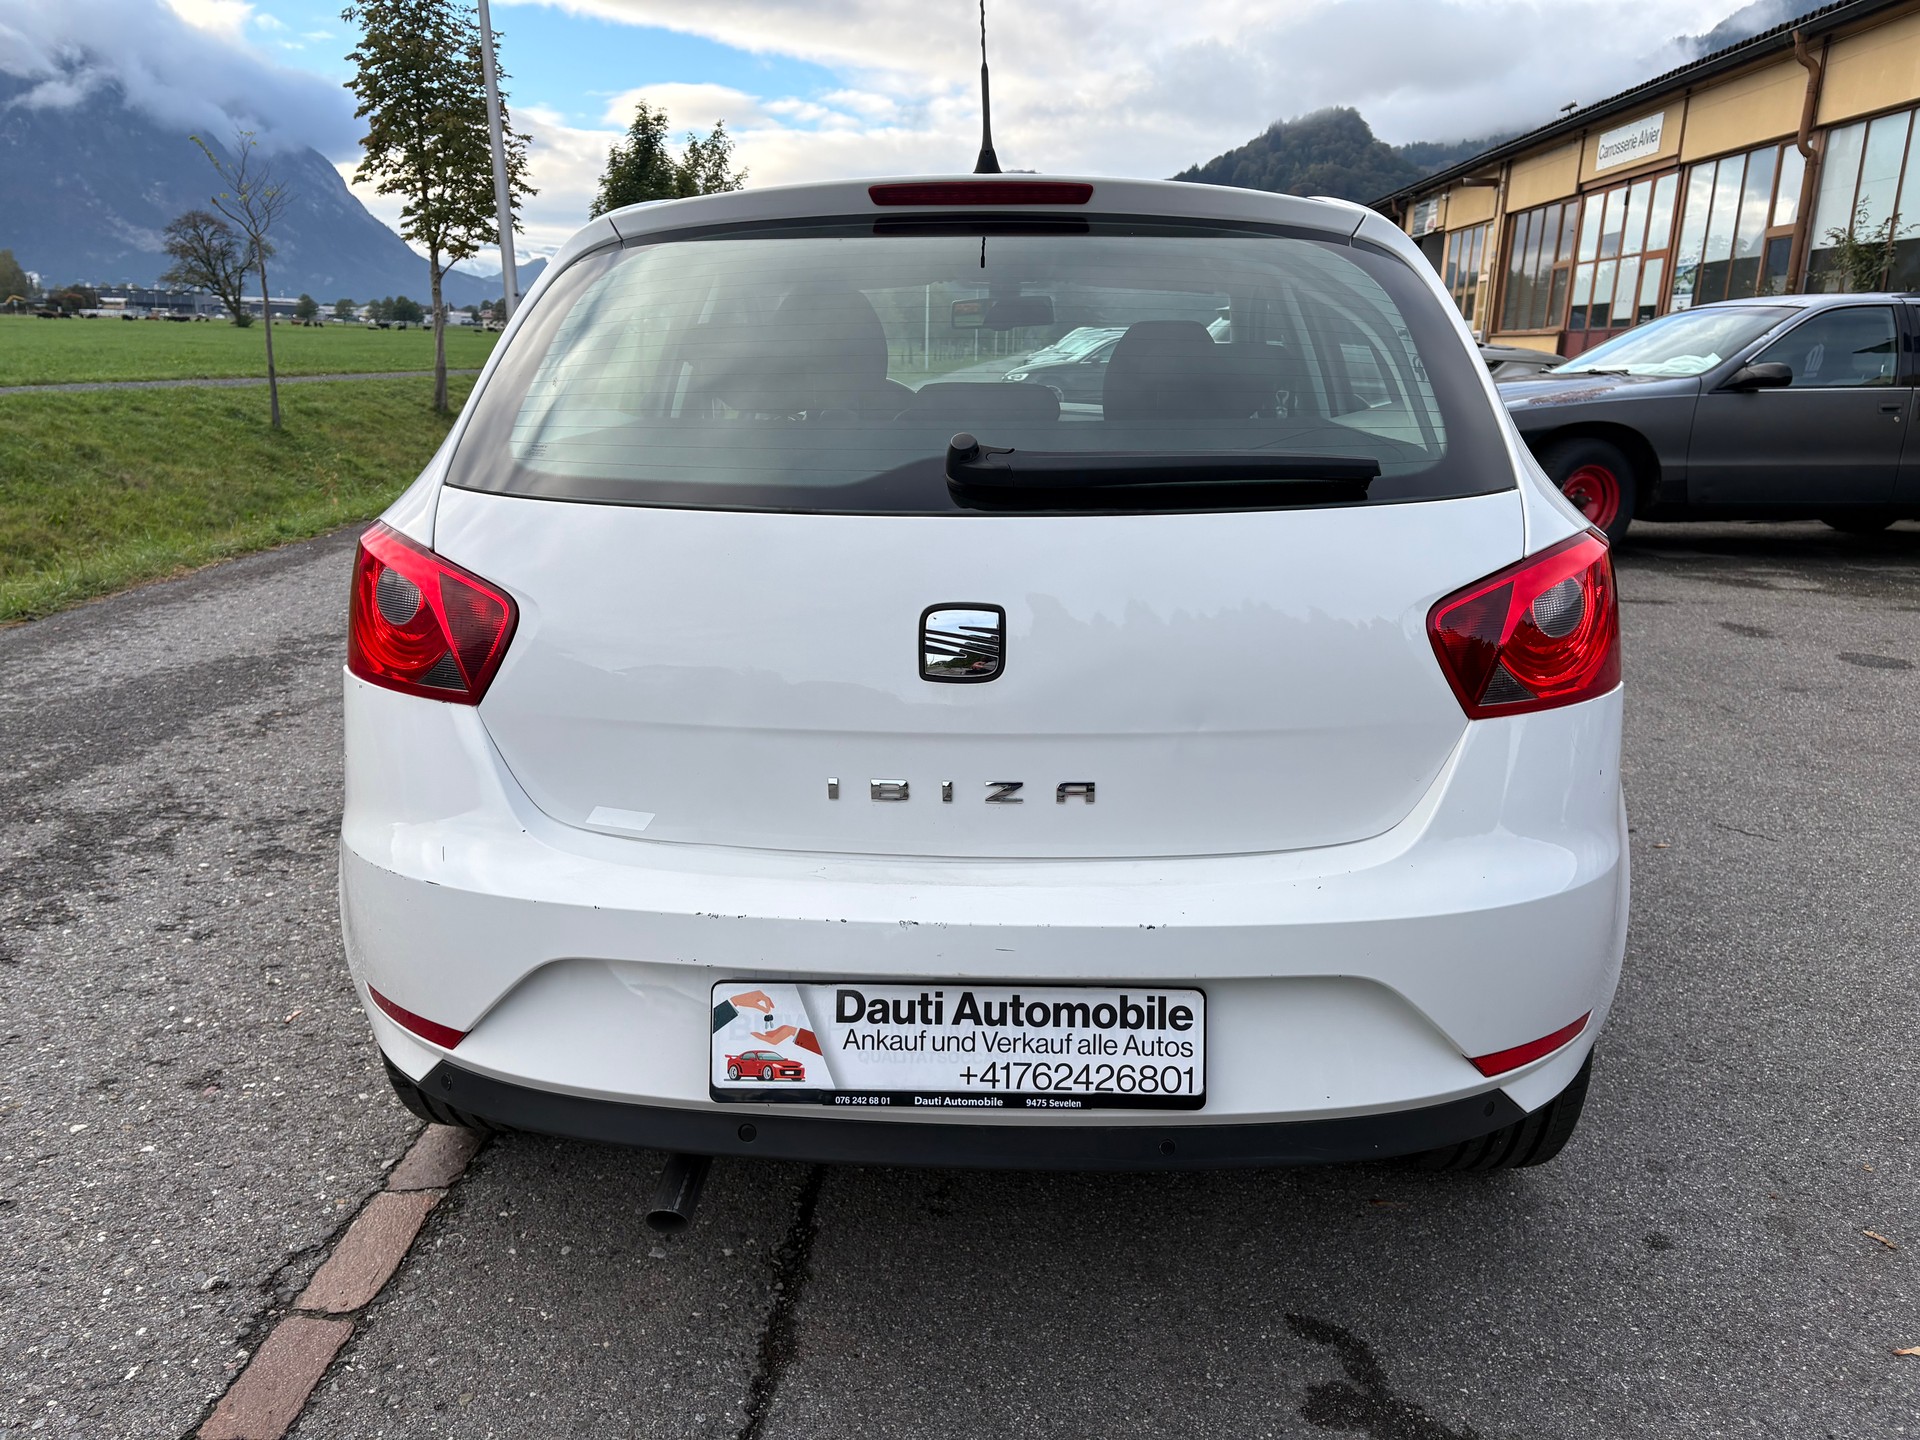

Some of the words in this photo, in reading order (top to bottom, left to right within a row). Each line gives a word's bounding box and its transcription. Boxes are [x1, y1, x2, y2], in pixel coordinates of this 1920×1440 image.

[827, 777, 1095, 804] IBIZA
[836, 989, 943, 1025] Dauti
[951, 991, 1194, 1031] Automobile
[842, 1028, 927, 1051] Ankauf
[932, 1031, 976, 1052] und
[981, 1031, 1072, 1055] Verkauf
[1077, 1033, 1118, 1055] alle
[1122, 1034, 1194, 1057] Autos
[959, 1061, 1195, 1094] +41762426801
[835, 1096, 850, 1104] 076
[852, 1096, 867, 1105] 242
[868, 1097, 879, 1105] 68
[881, 1097, 891, 1105] 01
[914, 1096, 941, 1106] Dauti
[944, 1097, 1003, 1107] Automobile
[1026, 1098, 1047, 1107] 9475
[1049, 1098, 1082, 1108] Sevelen
